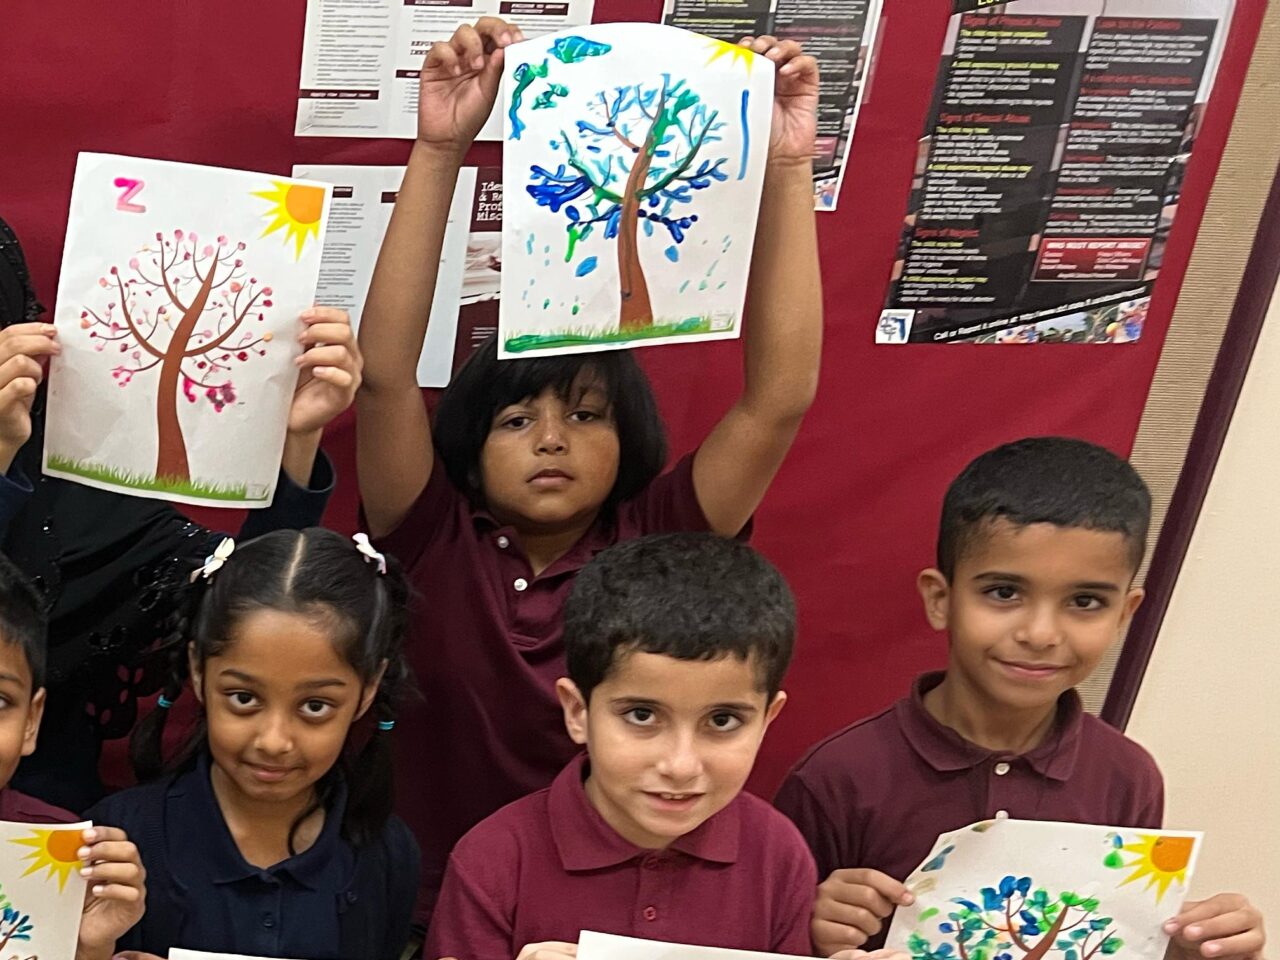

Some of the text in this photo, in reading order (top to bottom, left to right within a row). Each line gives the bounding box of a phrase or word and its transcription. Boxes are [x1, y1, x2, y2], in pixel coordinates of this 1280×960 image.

[481, 181, 503, 192] Ide
[114, 177, 147, 213] Z
[477, 201, 503, 211] Prof
[476, 211, 503, 222] Misc
